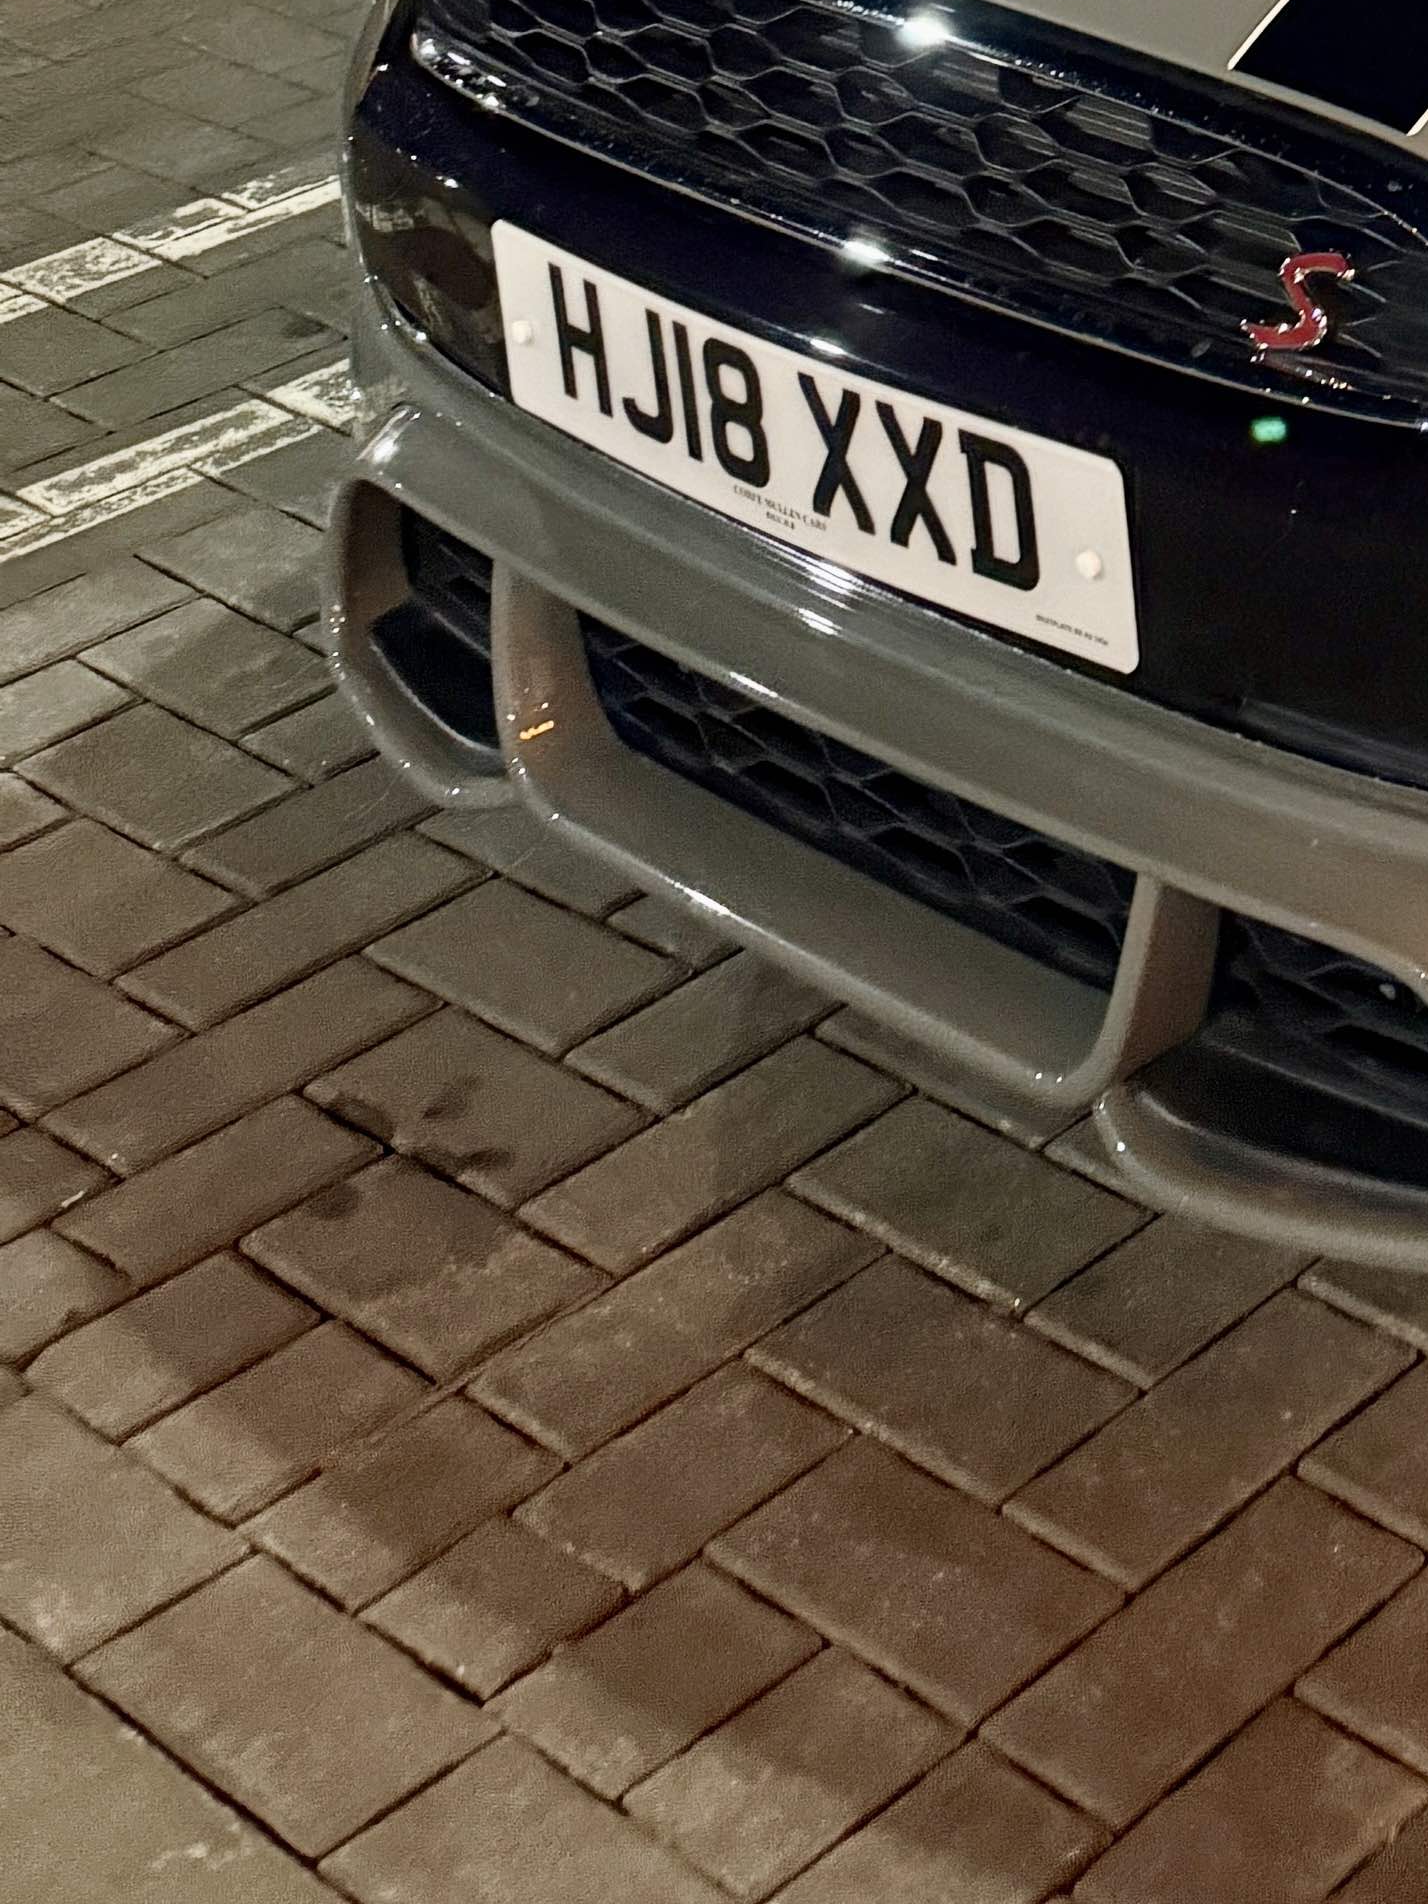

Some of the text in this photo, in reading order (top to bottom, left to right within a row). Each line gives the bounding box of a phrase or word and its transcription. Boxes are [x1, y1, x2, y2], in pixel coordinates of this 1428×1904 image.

[1240, 252, 1356, 351] S
[548, 263, 1041, 593] HJ18 XXD
